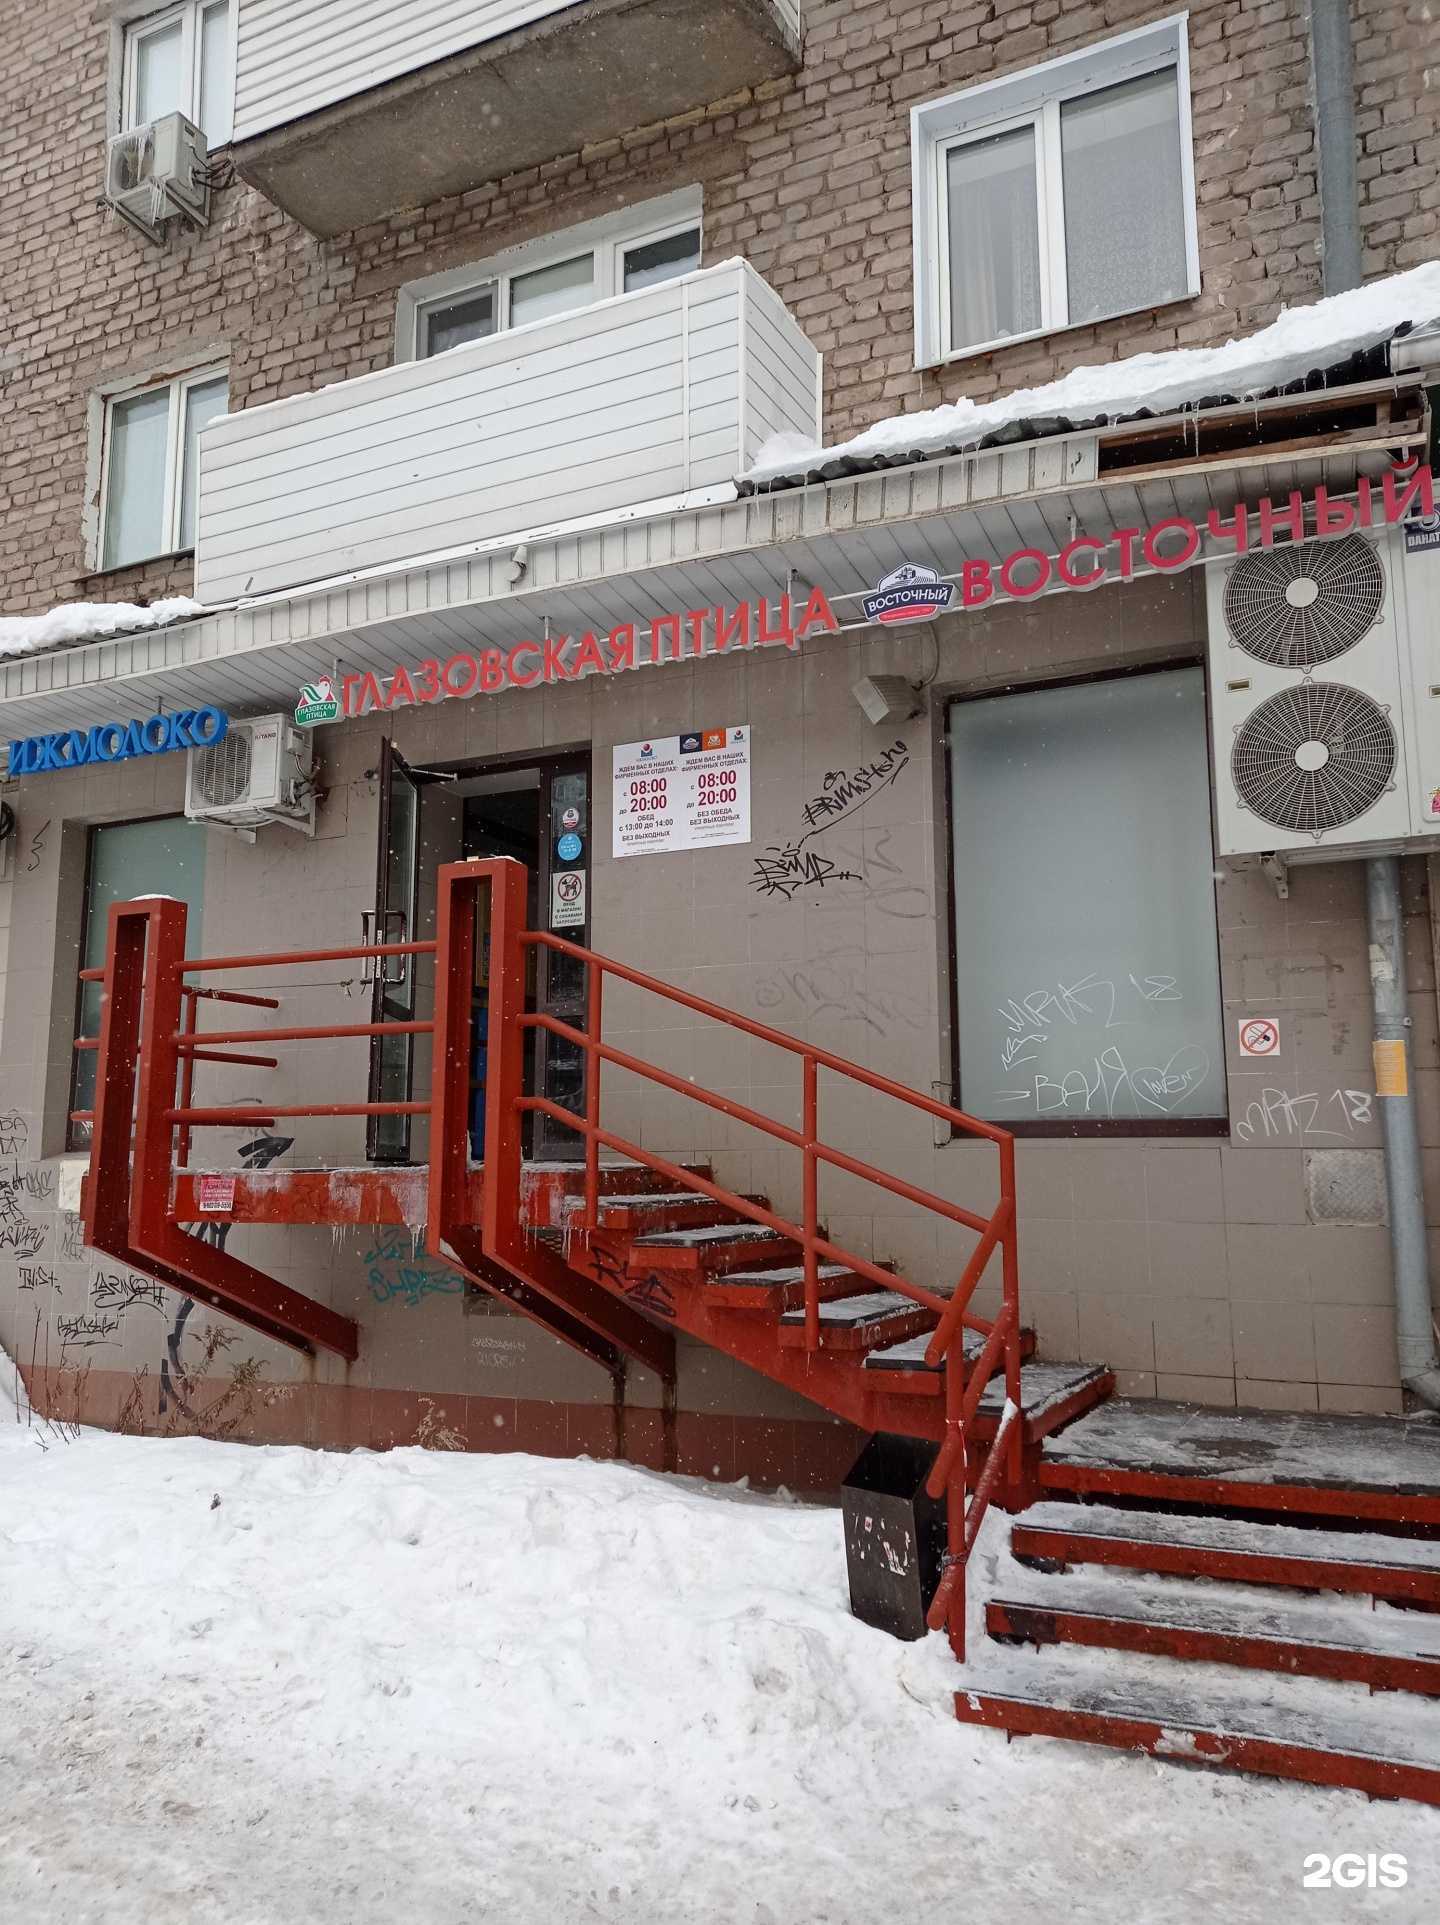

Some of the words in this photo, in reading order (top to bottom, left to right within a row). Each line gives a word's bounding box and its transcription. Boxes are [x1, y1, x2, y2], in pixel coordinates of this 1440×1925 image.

[962, 455, 1434, 607] ВОСТОЧНЫЙ
[867, 586, 949, 613] ВОСТОЧНЫЙ
[342, 624, 639, 717] ГЛАЗОВСКАЯ
[651, 585, 839, 662] ПТИЦА
[297, 703, 336, 716] ГЛАЗОВСКАЯ
[306, 710, 327, 720] ПТИЦА
[8, 704, 229, 775] ИЖМОЛОКО
[630, 778, 667, 796] 08:00
[698, 770, 737, 789] 08:00
[630, 795, 667, 812] 20:00
[698, 788, 737, 806] 20:00
[637, 813, 655, 821] ОБЕД
[689, 818, 702, 826] БЕЗ
[703, 814, 740, 824] ВЫХОДНЫХ
[697, 809, 709, 818] БЕЗ
[710, 808, 732, 816] ОБЕДА
[625, 822, 642, 832] 13:00
[644, 822, 654, 830] до
[655, 818, 674, 828] 14:00
[622, 834, 634, 842] БЕЗ
[635, 831, 670, 841] ВЫХОДНЫХ
